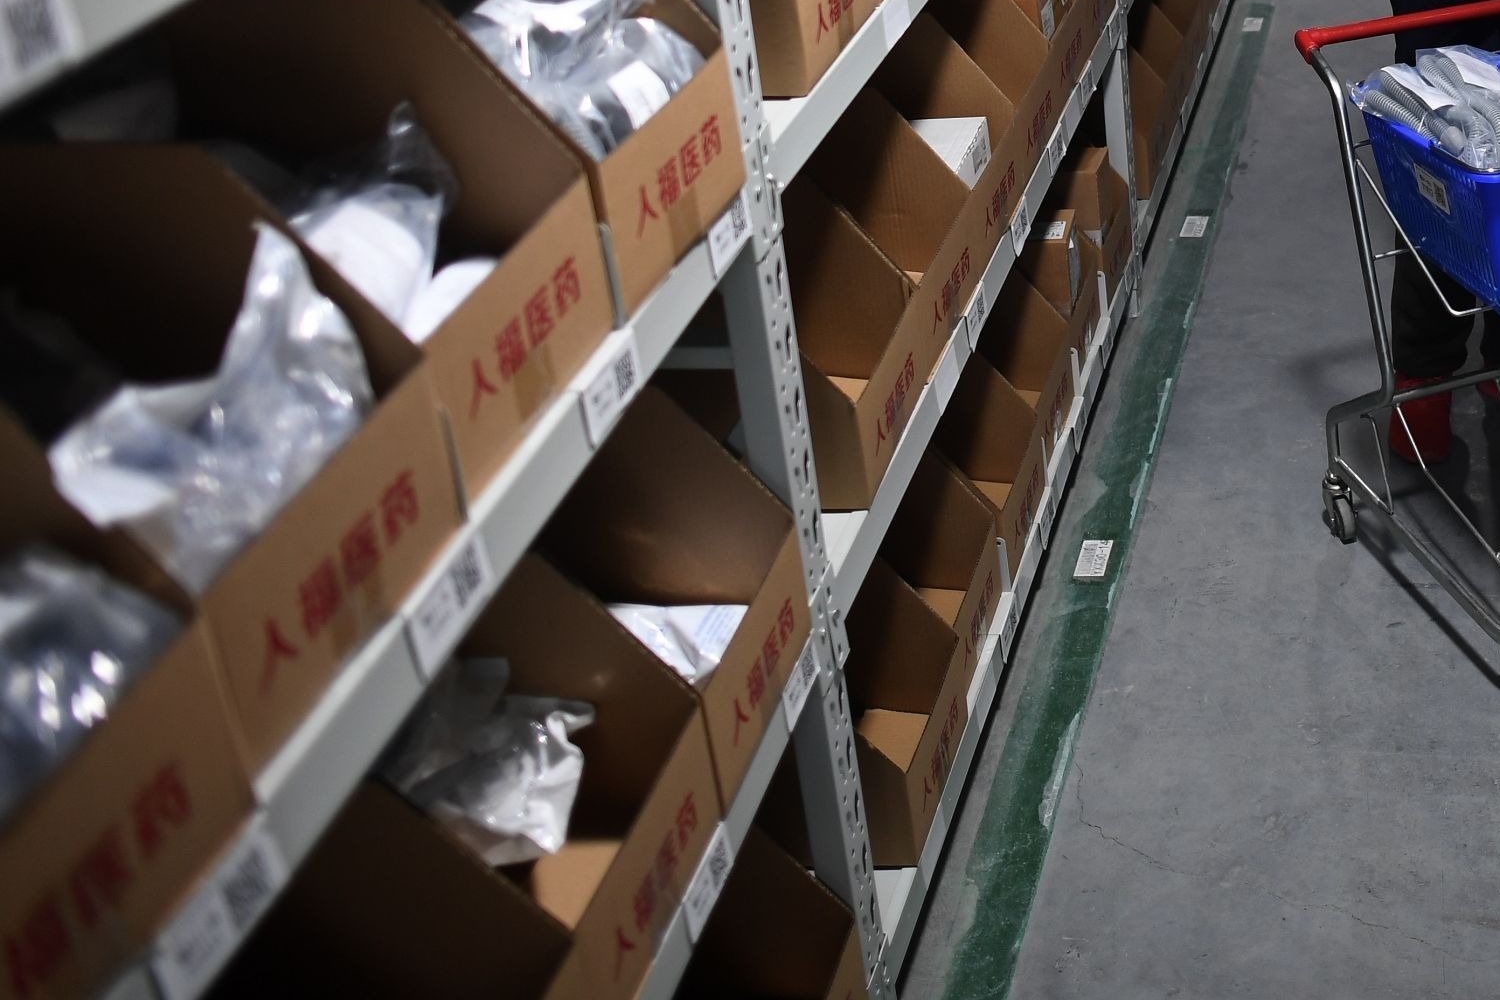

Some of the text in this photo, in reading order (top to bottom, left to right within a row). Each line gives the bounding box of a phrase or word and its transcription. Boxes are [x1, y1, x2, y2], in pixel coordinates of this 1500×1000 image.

[636, 114, 723, 239] 人福医药
[470, 256, 581, 421] 人福医药
[933, 246, 970, 335] 人福医药
[875, 351, 915, 457] 人福医药
[732, 598, 795, 747] 人福医药
[614, 793, 699, 982] 人福医药
